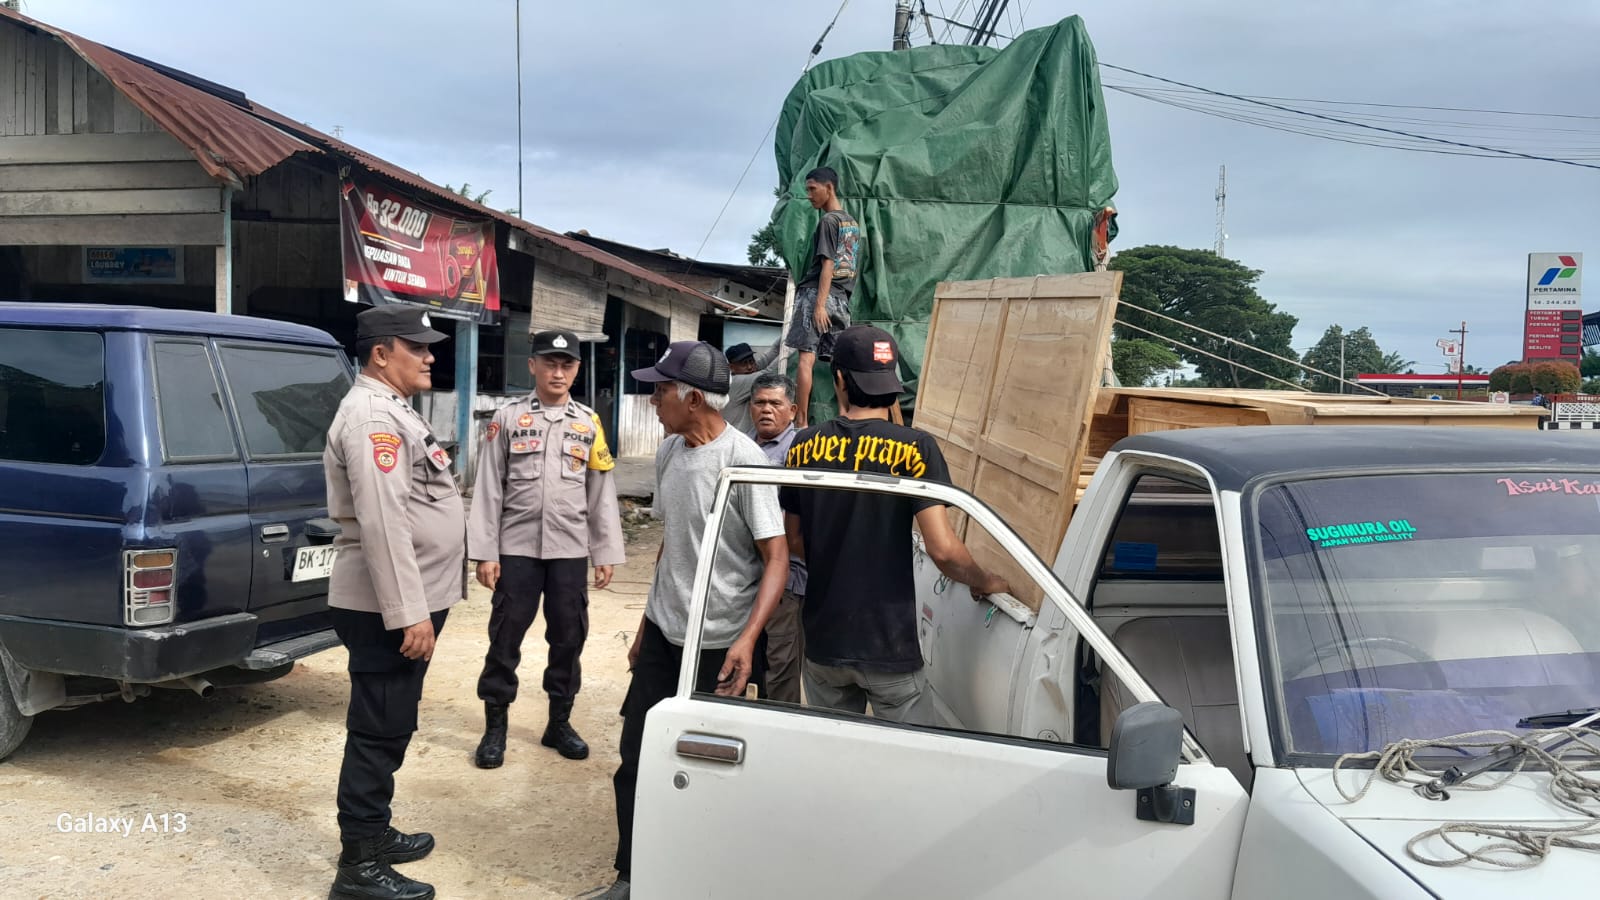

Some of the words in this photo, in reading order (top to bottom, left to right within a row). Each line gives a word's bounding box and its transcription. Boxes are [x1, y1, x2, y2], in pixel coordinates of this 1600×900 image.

[1559, 478, 1600, 495] Ka
[1307, 521, 1388, 541] SUGIMURA
[1389, 519, 1417, 533] OIL
[1321, 538, 1349, 547] JAPAN
[1350, 535, 1374, 544] HIGH
[1375, 532, 1413, 542] QUALITY
[319, 547, 340, 567] 17
